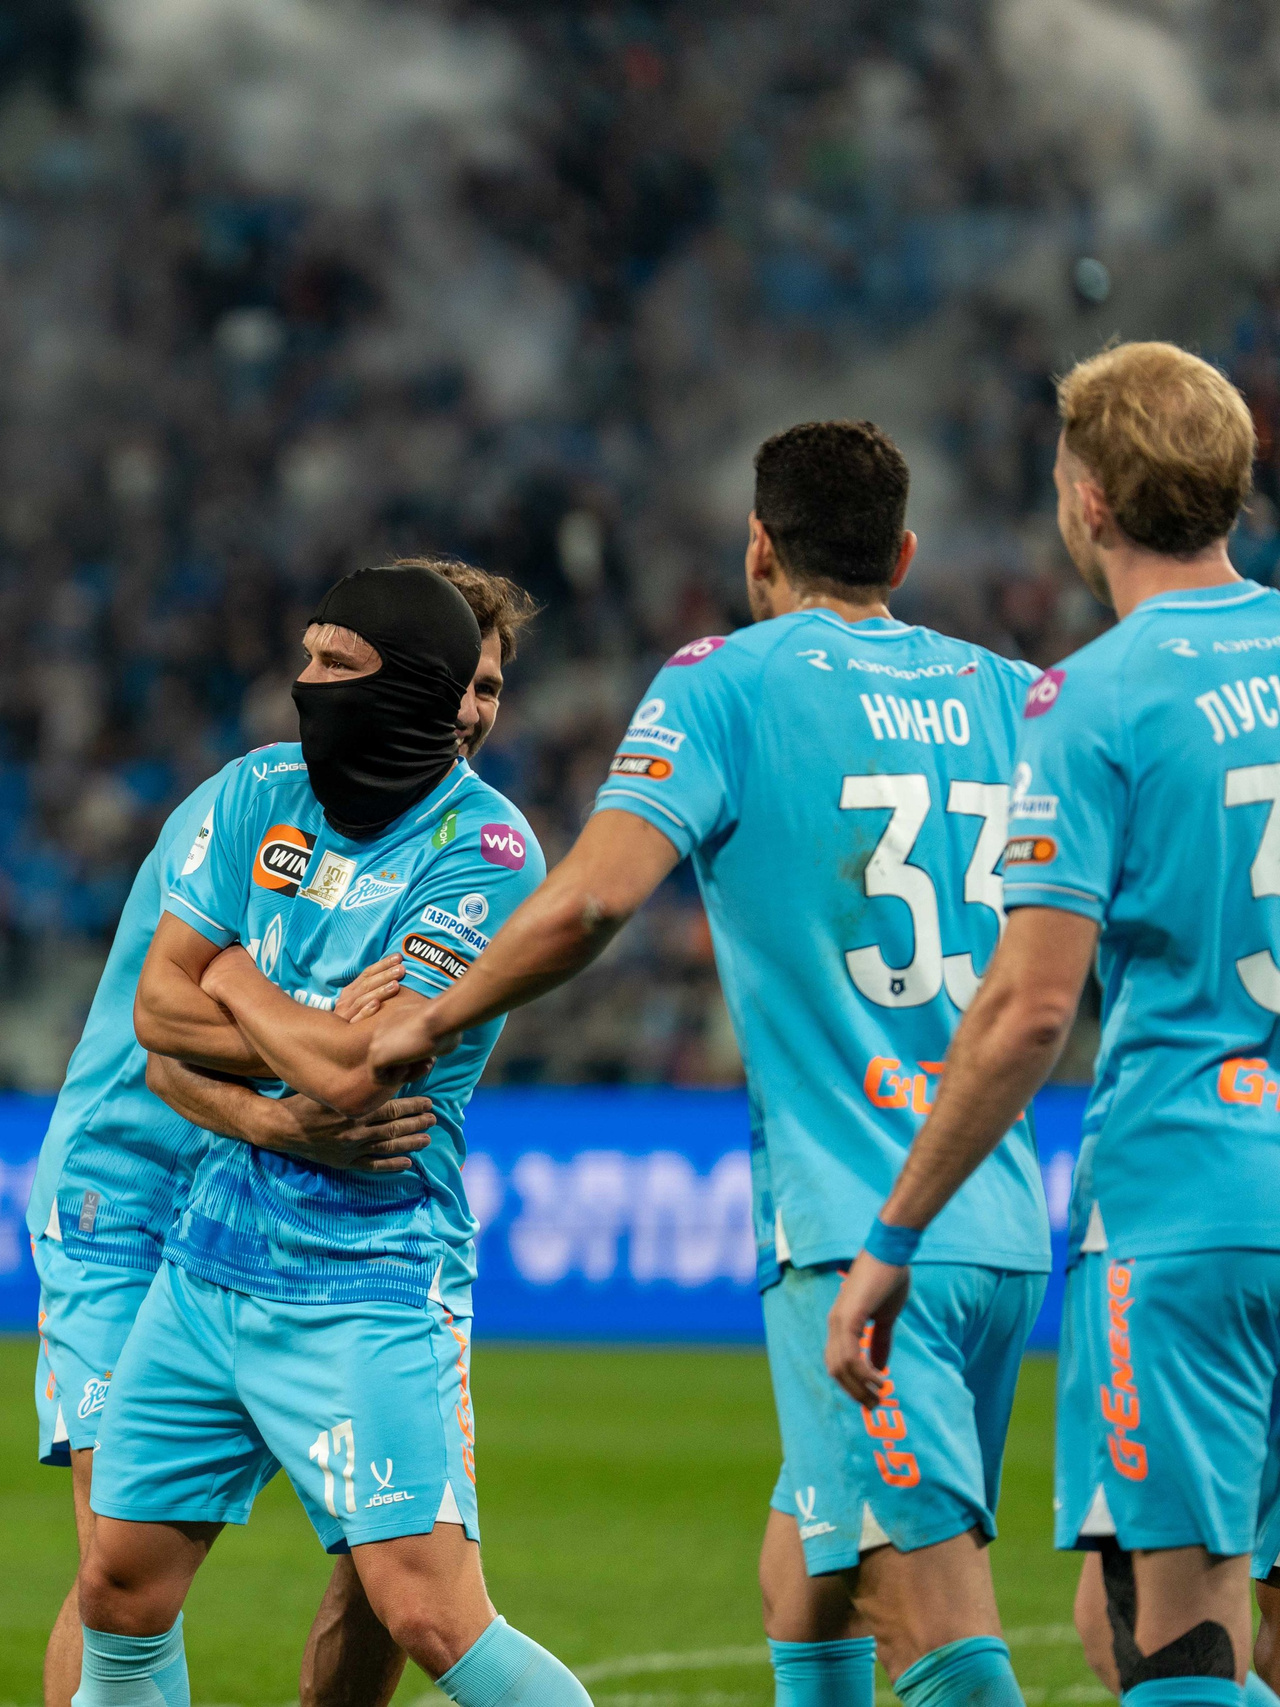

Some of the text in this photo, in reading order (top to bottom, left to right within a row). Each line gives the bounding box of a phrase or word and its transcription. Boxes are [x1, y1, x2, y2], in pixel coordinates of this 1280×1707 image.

[859, 692, 970, 746] НИНО
[269, 762, 309, 773] JÖGE
[483, 832, 525, 858] wb
[839, 773, 1010, 1013] 33
[424, 907, 490, 951] ГАЗПРОМБАН
[408, 938, 468, 979] WINLINE
[309, 1419, 357, 1519] 17
[364, 1490, 415, 1509] JÖGEL
